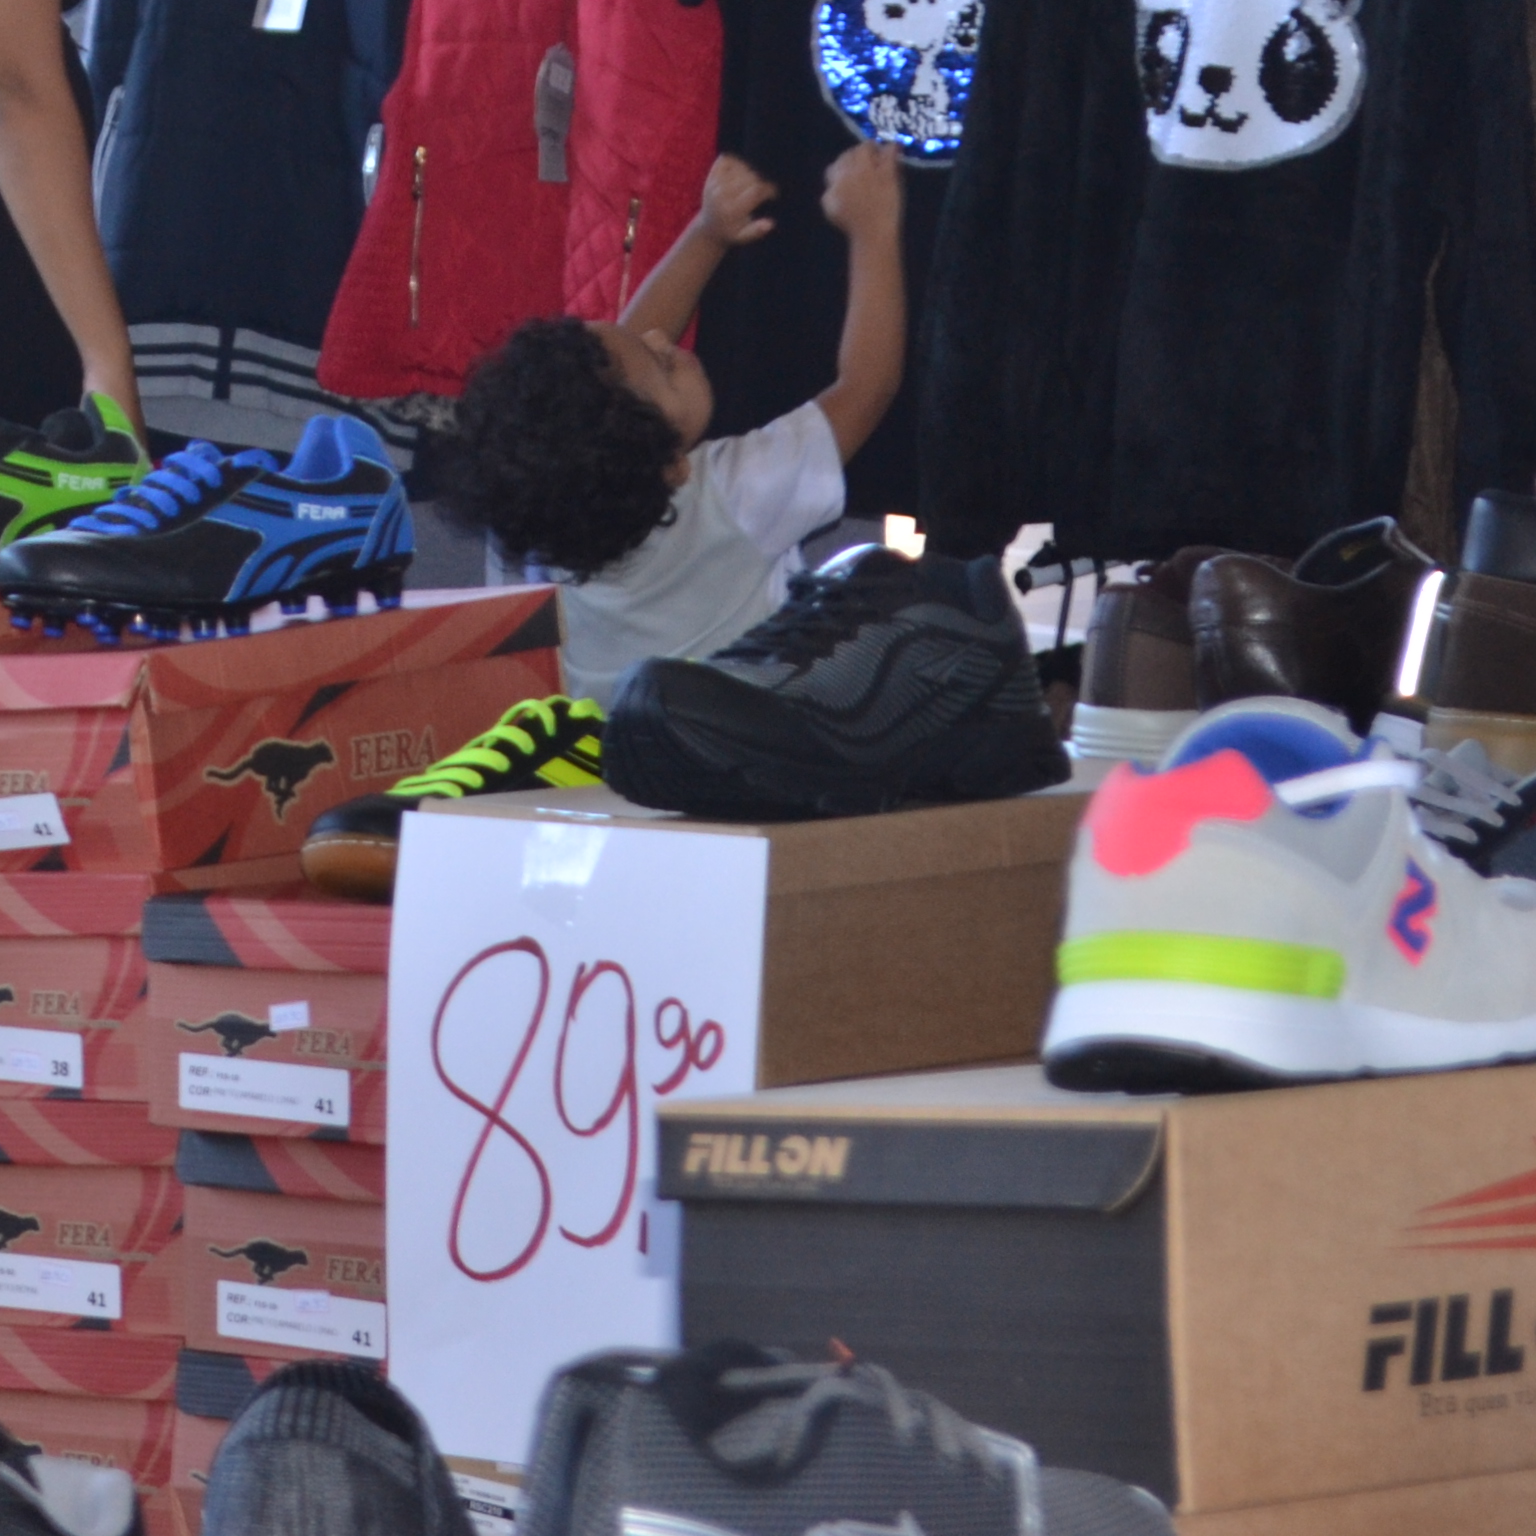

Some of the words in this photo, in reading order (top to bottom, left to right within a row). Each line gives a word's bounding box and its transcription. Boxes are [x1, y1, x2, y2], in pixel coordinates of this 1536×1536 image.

[57, 472, 105, 492] FERA
[297, 503, 347, 521] FERA
[351, 726, 437, 779] FERA
[33, 822, 54, 837] 41
[30, 990, 81, 1015] FERA
[295, 1030, 352, 1056] FERA
[50, 1060, 70, 1077] 38
[314, 1097, 335, 1115] 41
[684, 1132, 852, 1178] FILLON
[58, 1222, 113, 1248] FERA
[327, 1256, 382, 1286] FERA
[86, 1291, 107, 1308] 41
[351, 1329, 372, 1347] 41
[1362, 1287, 1525, 1393] FILL
